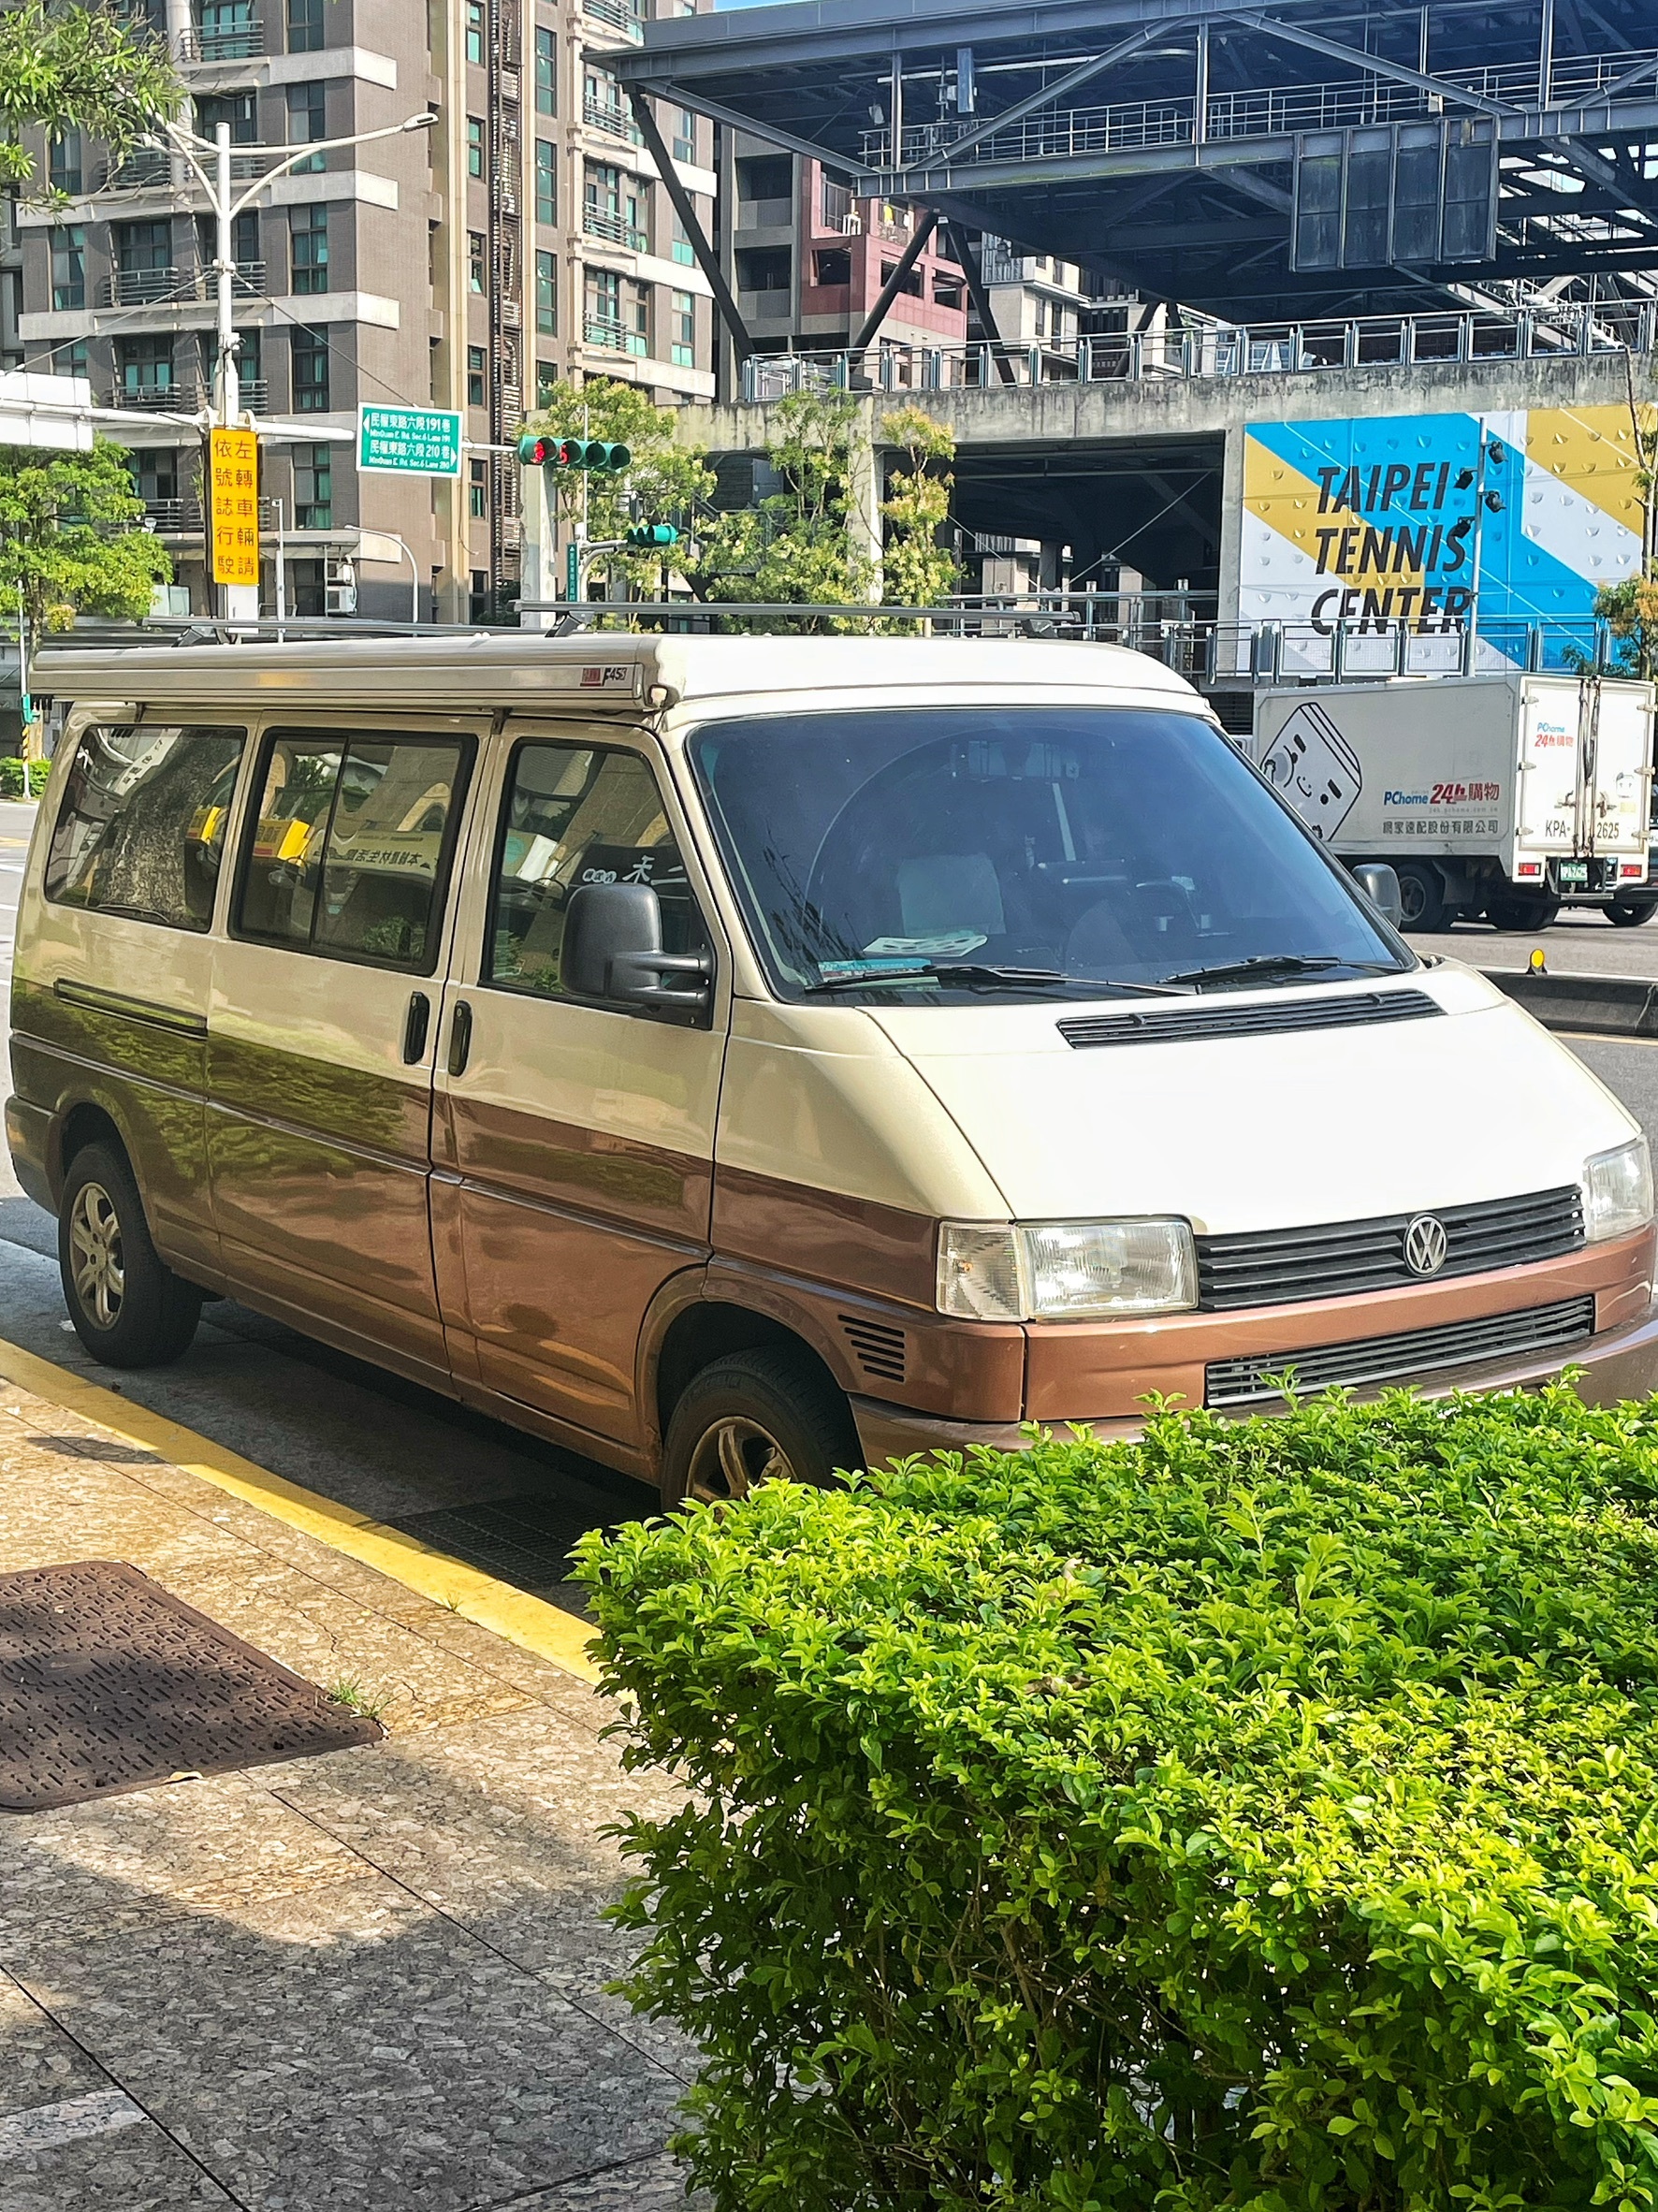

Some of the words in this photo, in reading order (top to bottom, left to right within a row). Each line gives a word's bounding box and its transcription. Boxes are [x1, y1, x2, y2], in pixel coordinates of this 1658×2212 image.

[214, 438, 234, 575] 依號誌行駛
[235, 439, 255, 575] 左轉車輛請
[1316, 461, 1450, 514] TAIPEI
[1316, 525, 1466, 575] TENNIS
[1311, 587, 1472, 636] CENTER
[1384, 791, 1429, 805] PChome
[1596, 822, 1620, 839] 2625
